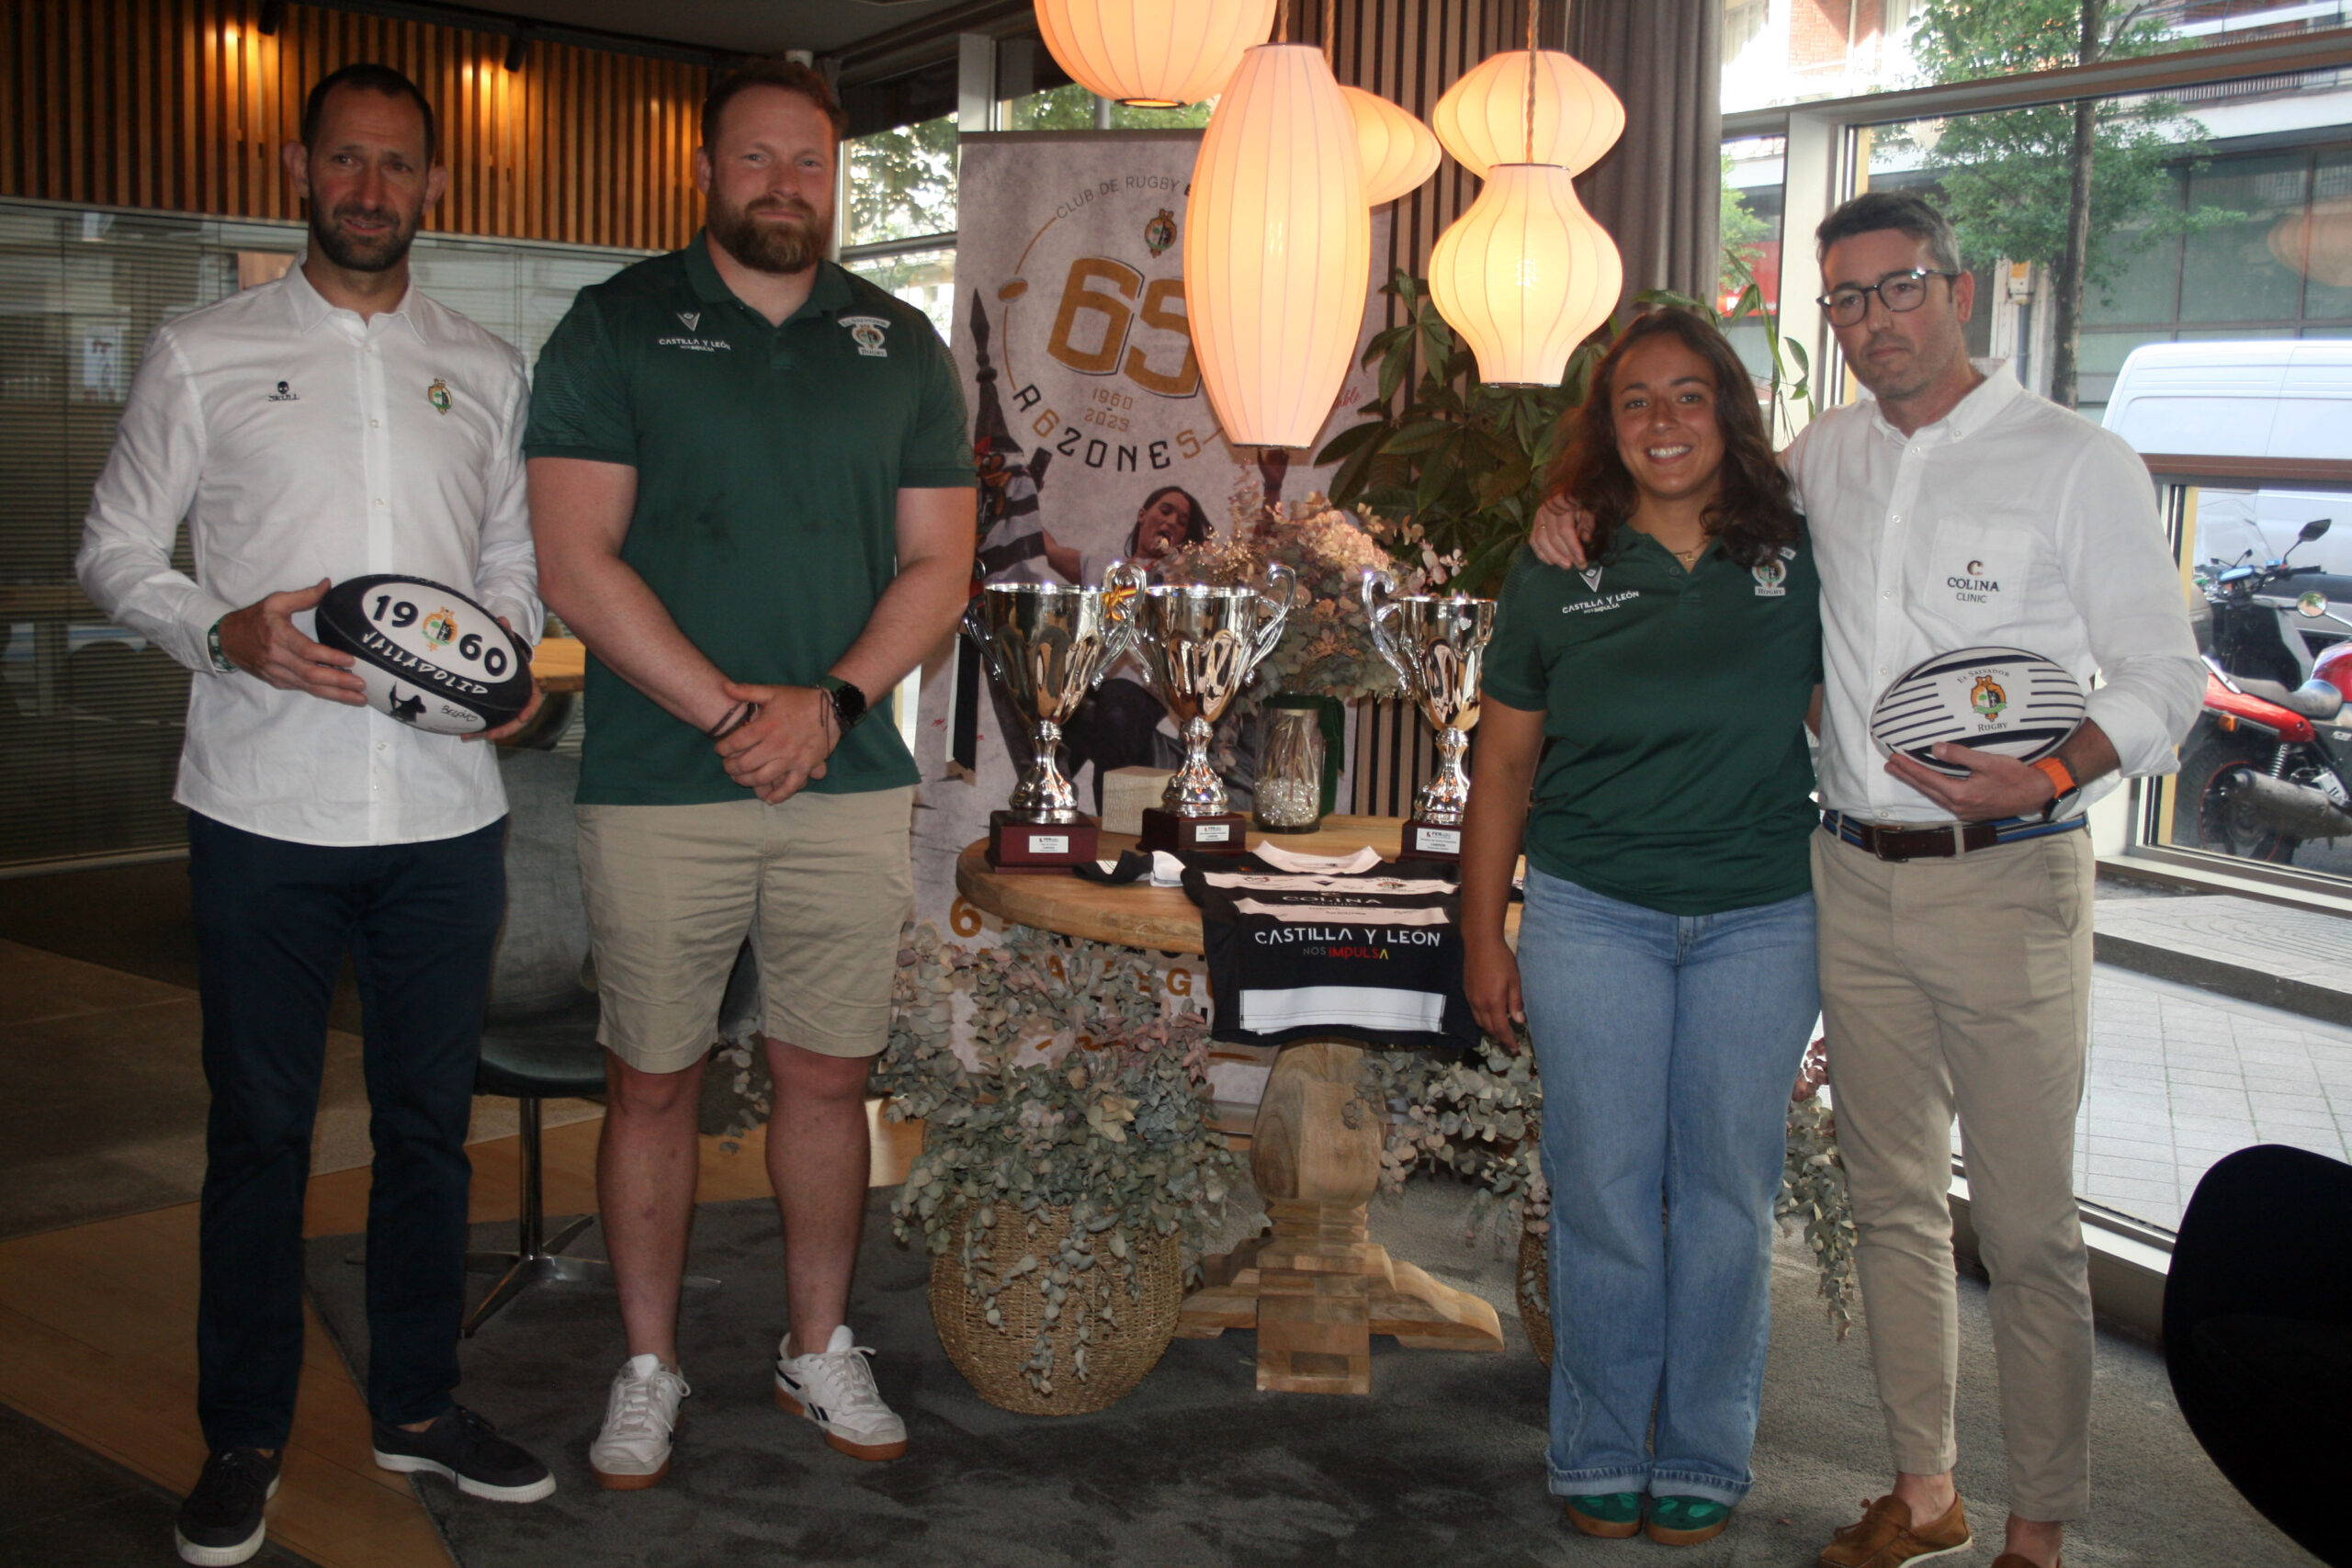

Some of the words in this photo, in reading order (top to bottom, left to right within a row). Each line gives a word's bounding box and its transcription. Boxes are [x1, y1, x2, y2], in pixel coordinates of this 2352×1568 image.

[1057, 189, 1094, 220] CLUB
[1100, 178, 1119, 196] DE
[1125, 175, 1181, 192] RUGBY
[658, 338, 700, 346] CASTILLA
[1092, 388, 1134, 412] 1960
[1084, 407, 1130, 433] 2025
[1947, 577, 2000, 592] COLINA
[1562, 599, 1604, 614] CASTILLA
[1606, 595, 1612, 604] Y
[1615, 590, 1640, 602] LEÓN
[1956, 592, 1987, 604] CLINIC
[363, 631, 489, 694] VALLADOLID
[1968, 668, 2010, 679] SALVADOR
[1977, 722, 2008, 732] RUGBY
[1283, 896, 1383, 906] COLINA
[1255, 927, 1353, 945] CASTILLA
[1364, 928, 1377, 945] Y
[1386, 929, 1441, 947] LEÓN
[1303, 946, 1327, 956] NOS
[1328, 946, 1389, 961] IMPULSA
